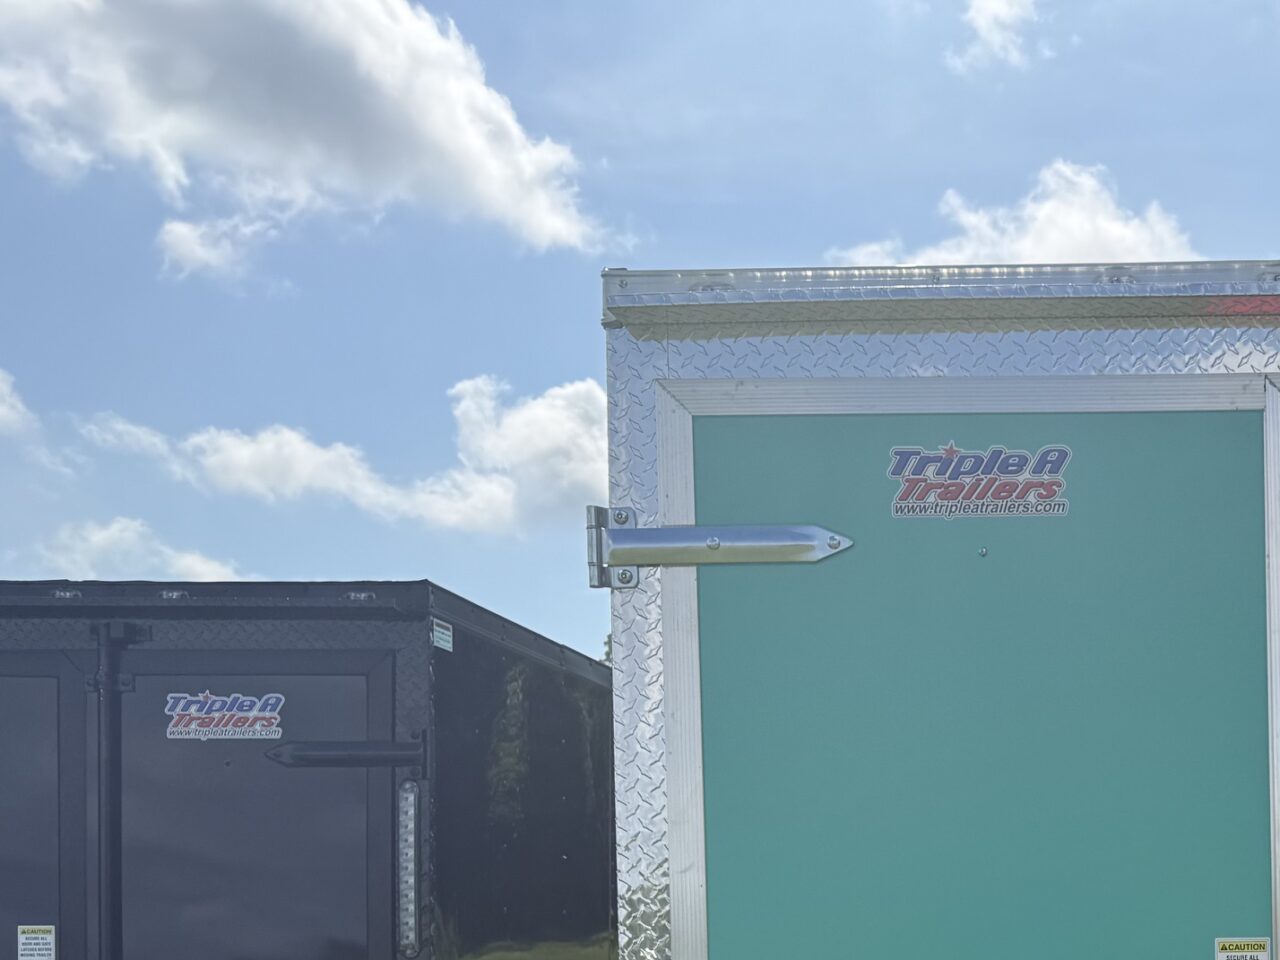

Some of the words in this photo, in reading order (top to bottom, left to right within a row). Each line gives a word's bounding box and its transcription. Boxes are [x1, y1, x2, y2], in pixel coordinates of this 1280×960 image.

[889, 448, 1029, 481] Triple
[1029, 448, 1070, 476] A
[898, 476, 1063, 501] Trailers
[894, 500, 1067, 517] www.tripleatrailers.com
[167, 695, 257, 715] Triple
[258, 695, 282, 713] A
[171, 712, 279, 729] Trailers
[168, 728, 281, 738] www.tripleatrailers.com
[1228, 943, 1266, 951] CAUTION
